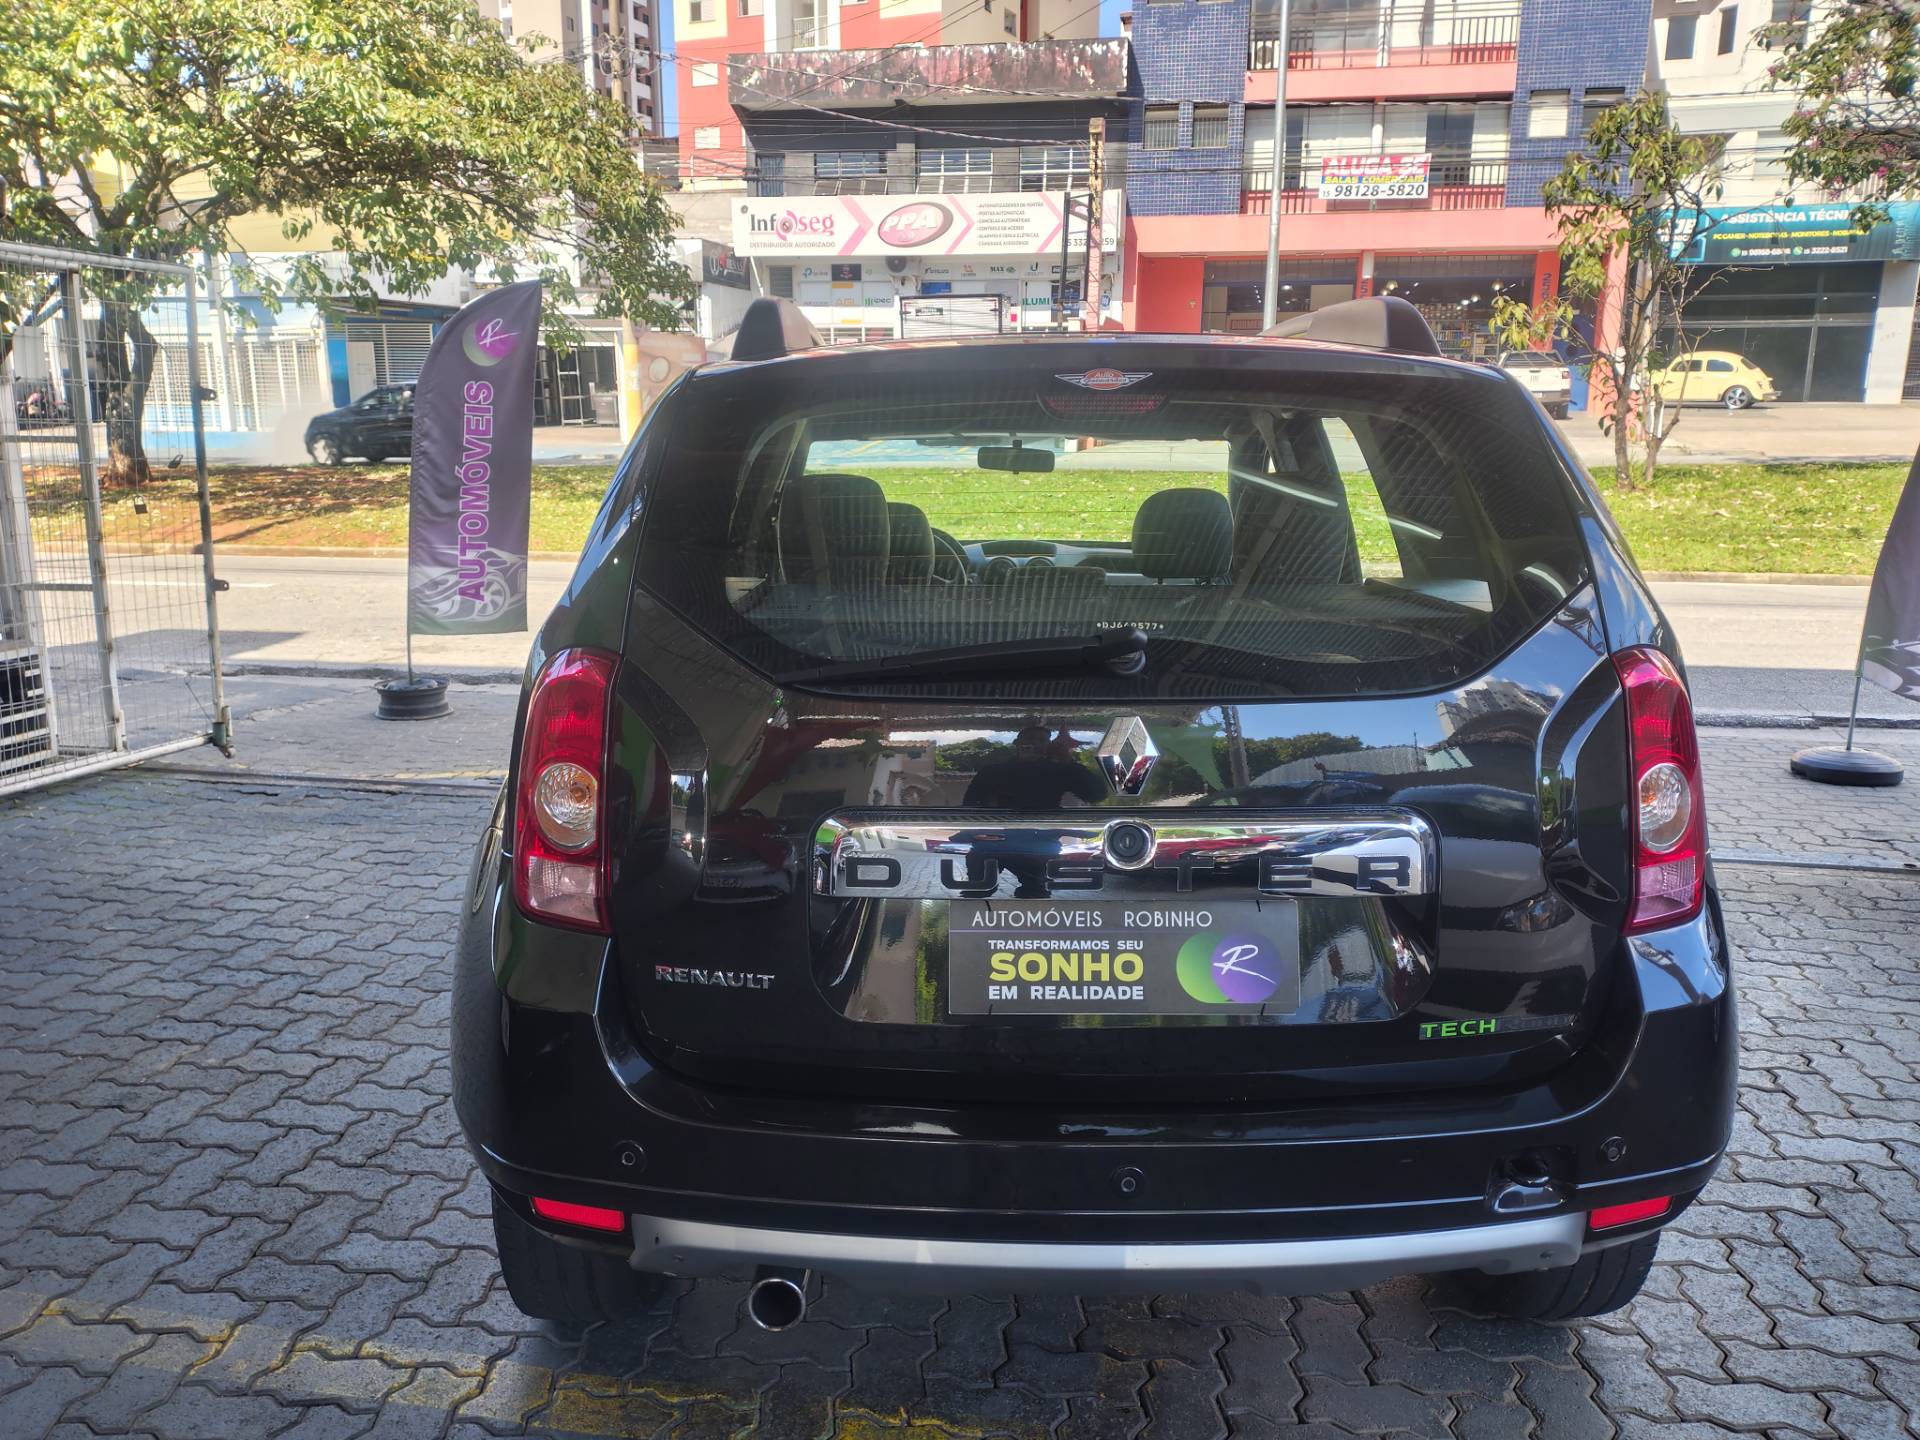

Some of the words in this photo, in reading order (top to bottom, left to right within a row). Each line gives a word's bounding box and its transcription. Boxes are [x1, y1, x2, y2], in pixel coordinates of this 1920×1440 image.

[1324, 154, 1427, 176] ALUGA-SE
[1324, 175, 1359, 184] SALAS
[1334, 184, 1425, 197] 98128-5820
[882, 208, 937, 232] PPA
[1720, 209, 1806, 224] ASSISTÊNCIA
[1808, 207, 1862, 222] TÉCNI
[749, 241, 793, 249] DISTRIBUIDOR
[455, 379, 494, 603] AUTOMÓVEIS
[845, 855, 1411, 893] DUSTER
[972, 906, 1103, 928] AUTOMÓVEIS
[1124, 910, 1213, 928] ROBINHO
[988, 939, 1110, 950] TRANSFORMAMOS
[1116, 939, 1144, 950] SEU
[655, 964, 775, 990] RENAULT
[989, 952, 1145, 982] SONHO
[988, 985, 1018, 1000] EM
[1030, 985, 1144, 1000] REALIDADE
[1421, 1018, 1496, 1038] TECH
